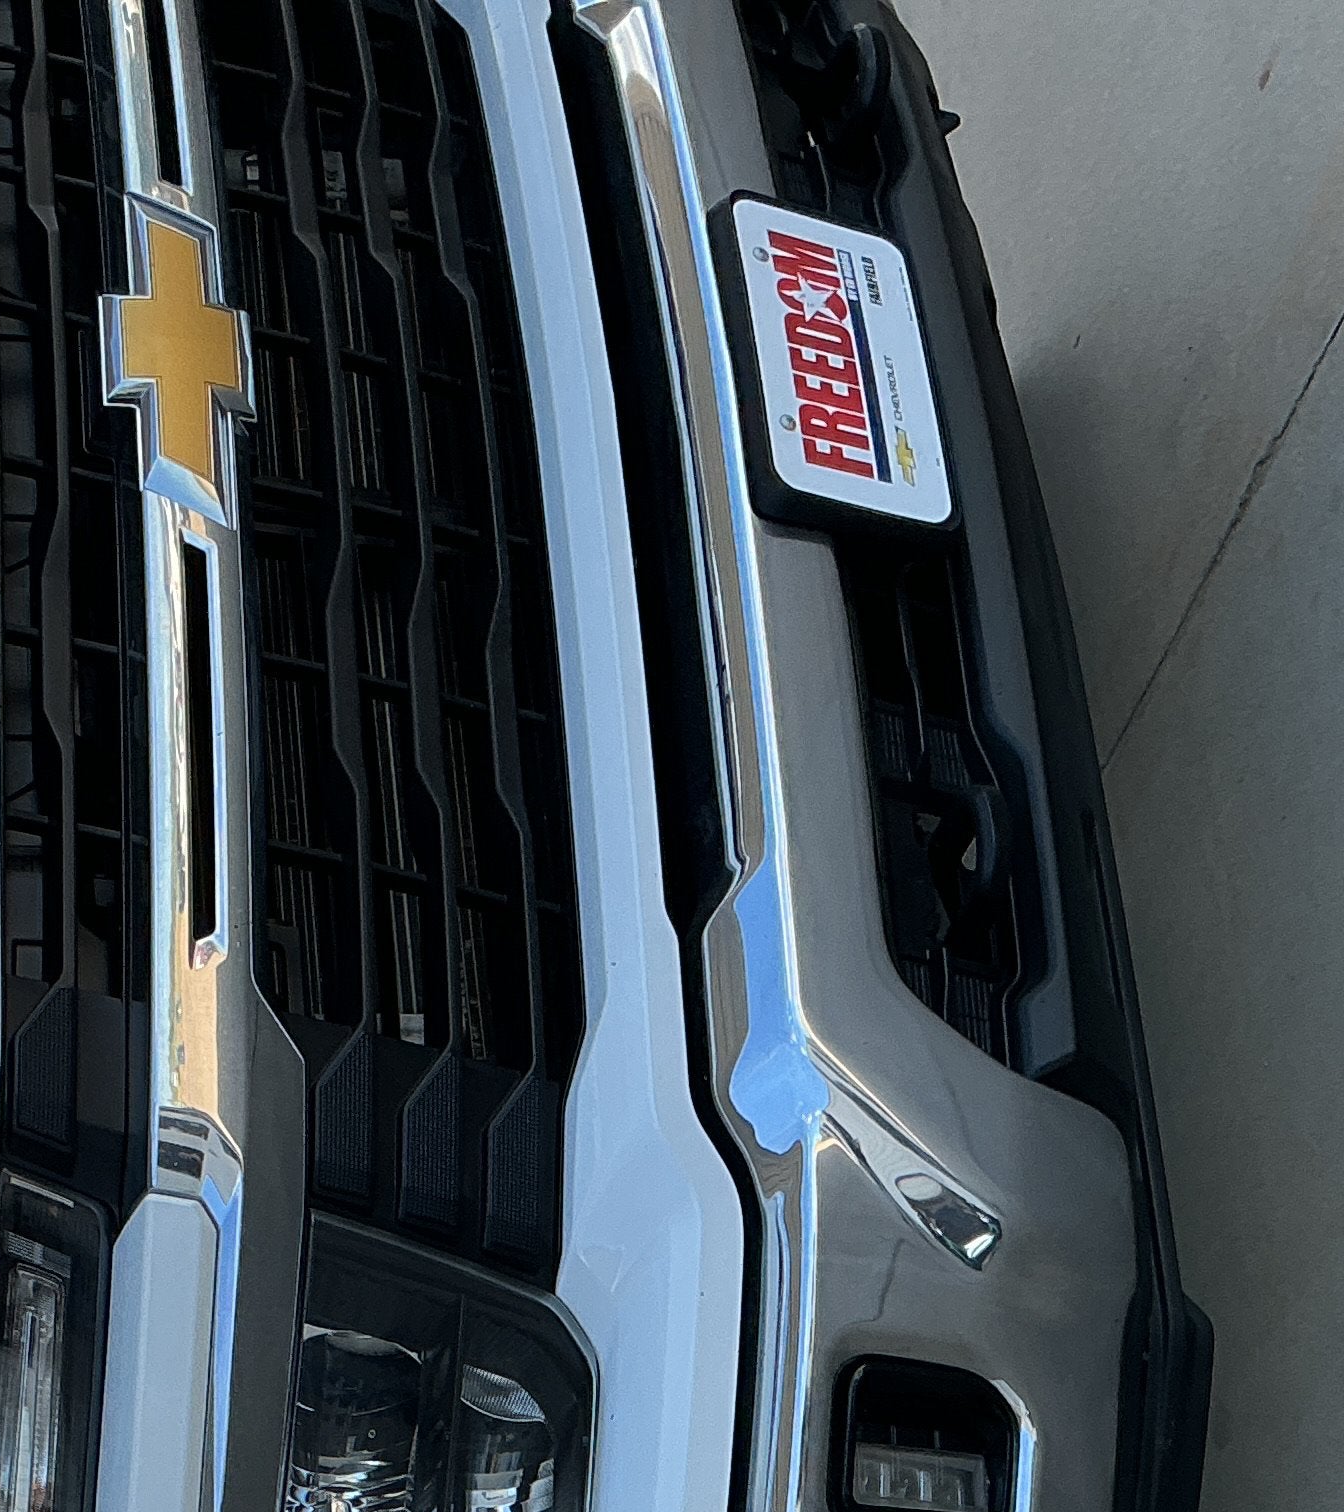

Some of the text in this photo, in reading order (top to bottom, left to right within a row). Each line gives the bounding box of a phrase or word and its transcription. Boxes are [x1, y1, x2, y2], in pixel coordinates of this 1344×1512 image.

[861, 255, 883, 307] FAIRFIELD
[766, 228, 876, 480] FREEDOM
[882, 354, 904, 422] CHEVROLET
